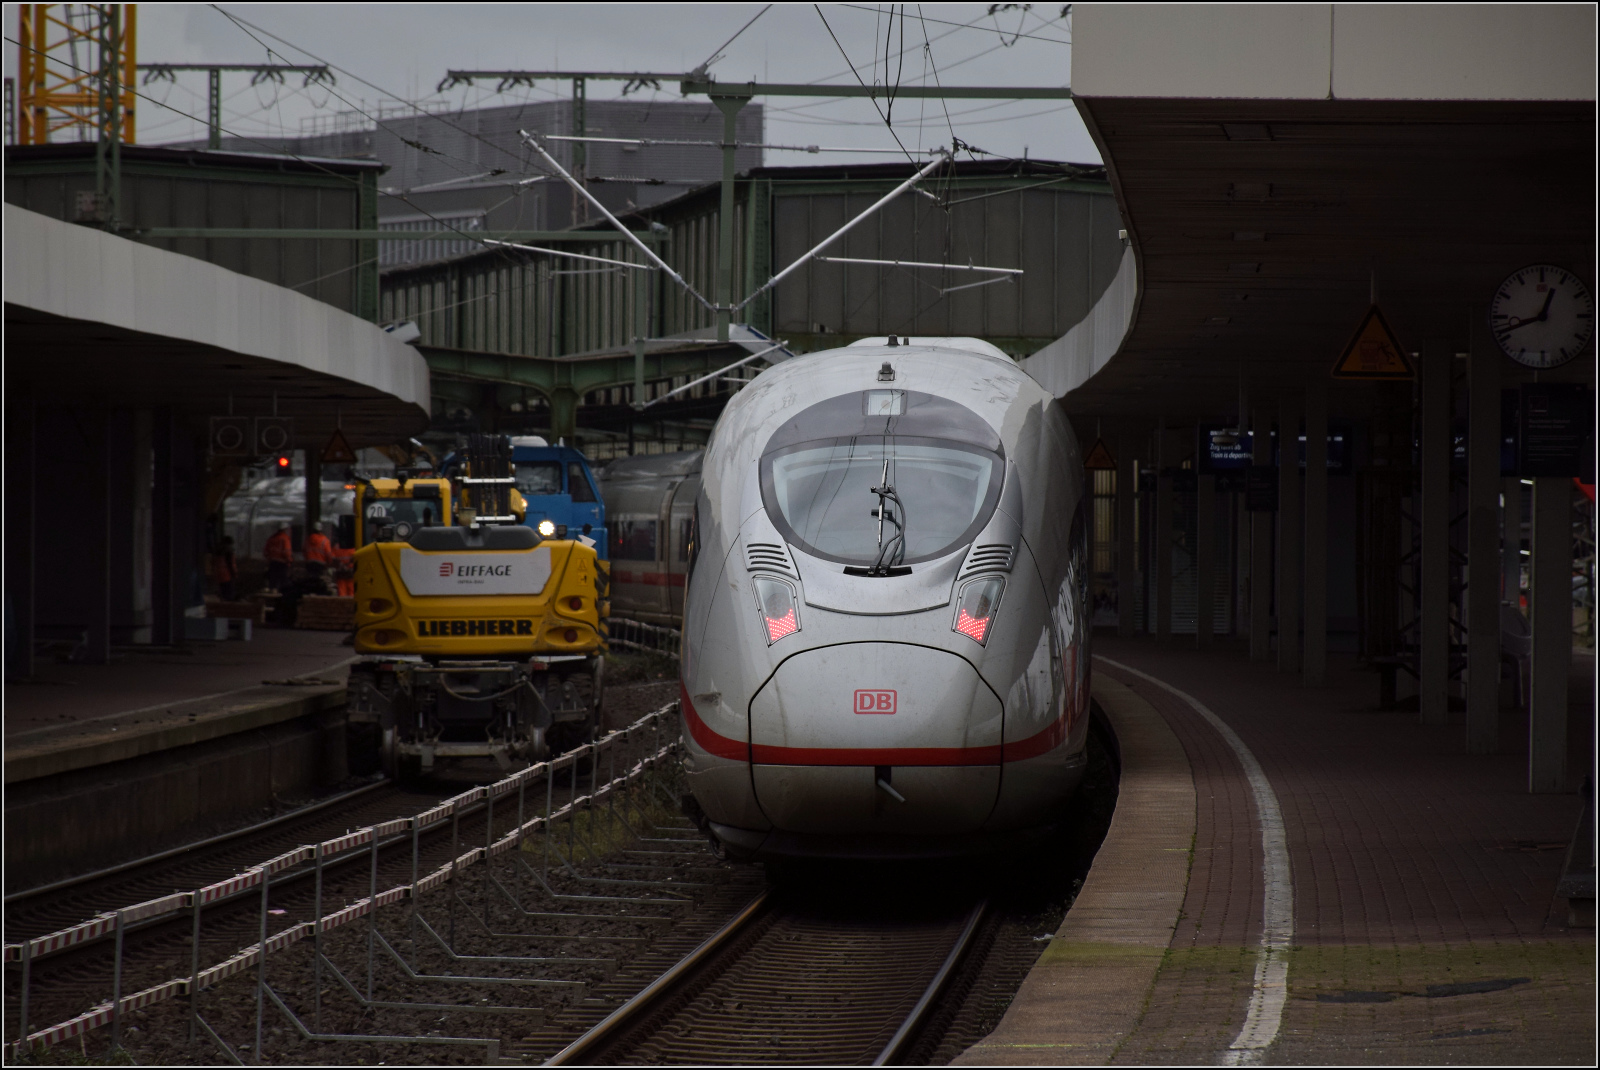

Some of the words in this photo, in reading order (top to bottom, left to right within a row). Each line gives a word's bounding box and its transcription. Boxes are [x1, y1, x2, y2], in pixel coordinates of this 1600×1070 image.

[1210, 443, 1220, 451] Zug
[1234, 443, 1242, 451] ab
[1210, 451, 1223, 459] Train
[370, 506, 383, 518] 20
[457, 565, 512, 577] EIFFAGE
[418, 619, 533, 637] LIEBHERR
[858, 692, 893, 712] DB
